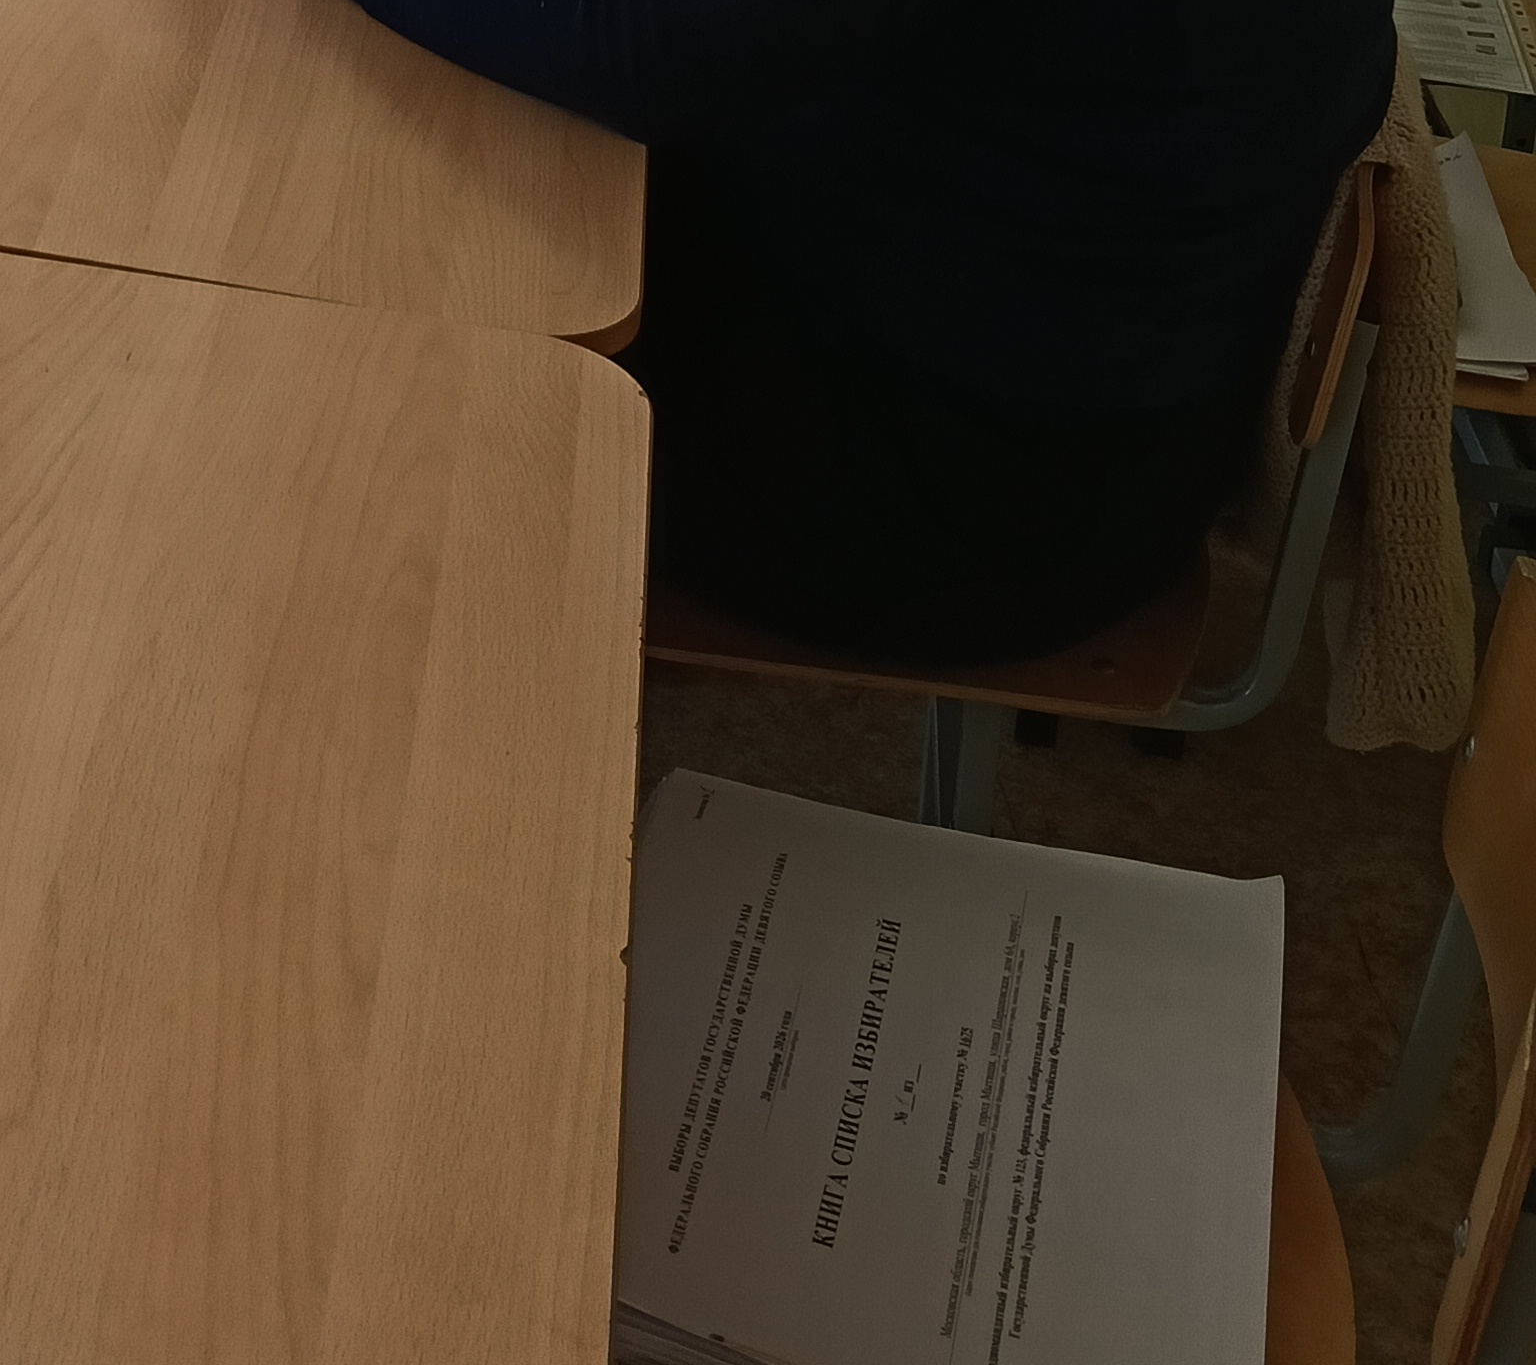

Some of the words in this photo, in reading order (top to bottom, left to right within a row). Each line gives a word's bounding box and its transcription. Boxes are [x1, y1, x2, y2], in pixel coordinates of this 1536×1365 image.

[667, 1122, 692, 1172] ВЫБОРЫ
[683, 1054, 711, 1122] ДЕПУТАТОВ
[702, 939, 743, 1052] ГОСУДАРСТВЕННОЙ
[734, 903, 752, 939] ДУМЫ
[667, 1160, 703, 1253] ФЕДЕРАЛЬНОГО
[695, 1096, 721, 1158] СОБРАНИЯ
[713, 1017, 743, 1096] РОССИЙСКОЙ
[735, 945, 762, 1015] ФЕДЕРАЦИИ
[753, 887, 777, 945] ДЕВЯТОГО
[811, 1174, 848, 1248] КНИГА
[830, 1079, 869, 1165] СПИСКА
[851, 917, 901, 1071] ИЗБИРАТЕЛЕЙ
[903, 1079, 914, 1093] из
[984, 1289, 1008, 1365] дномандатный
